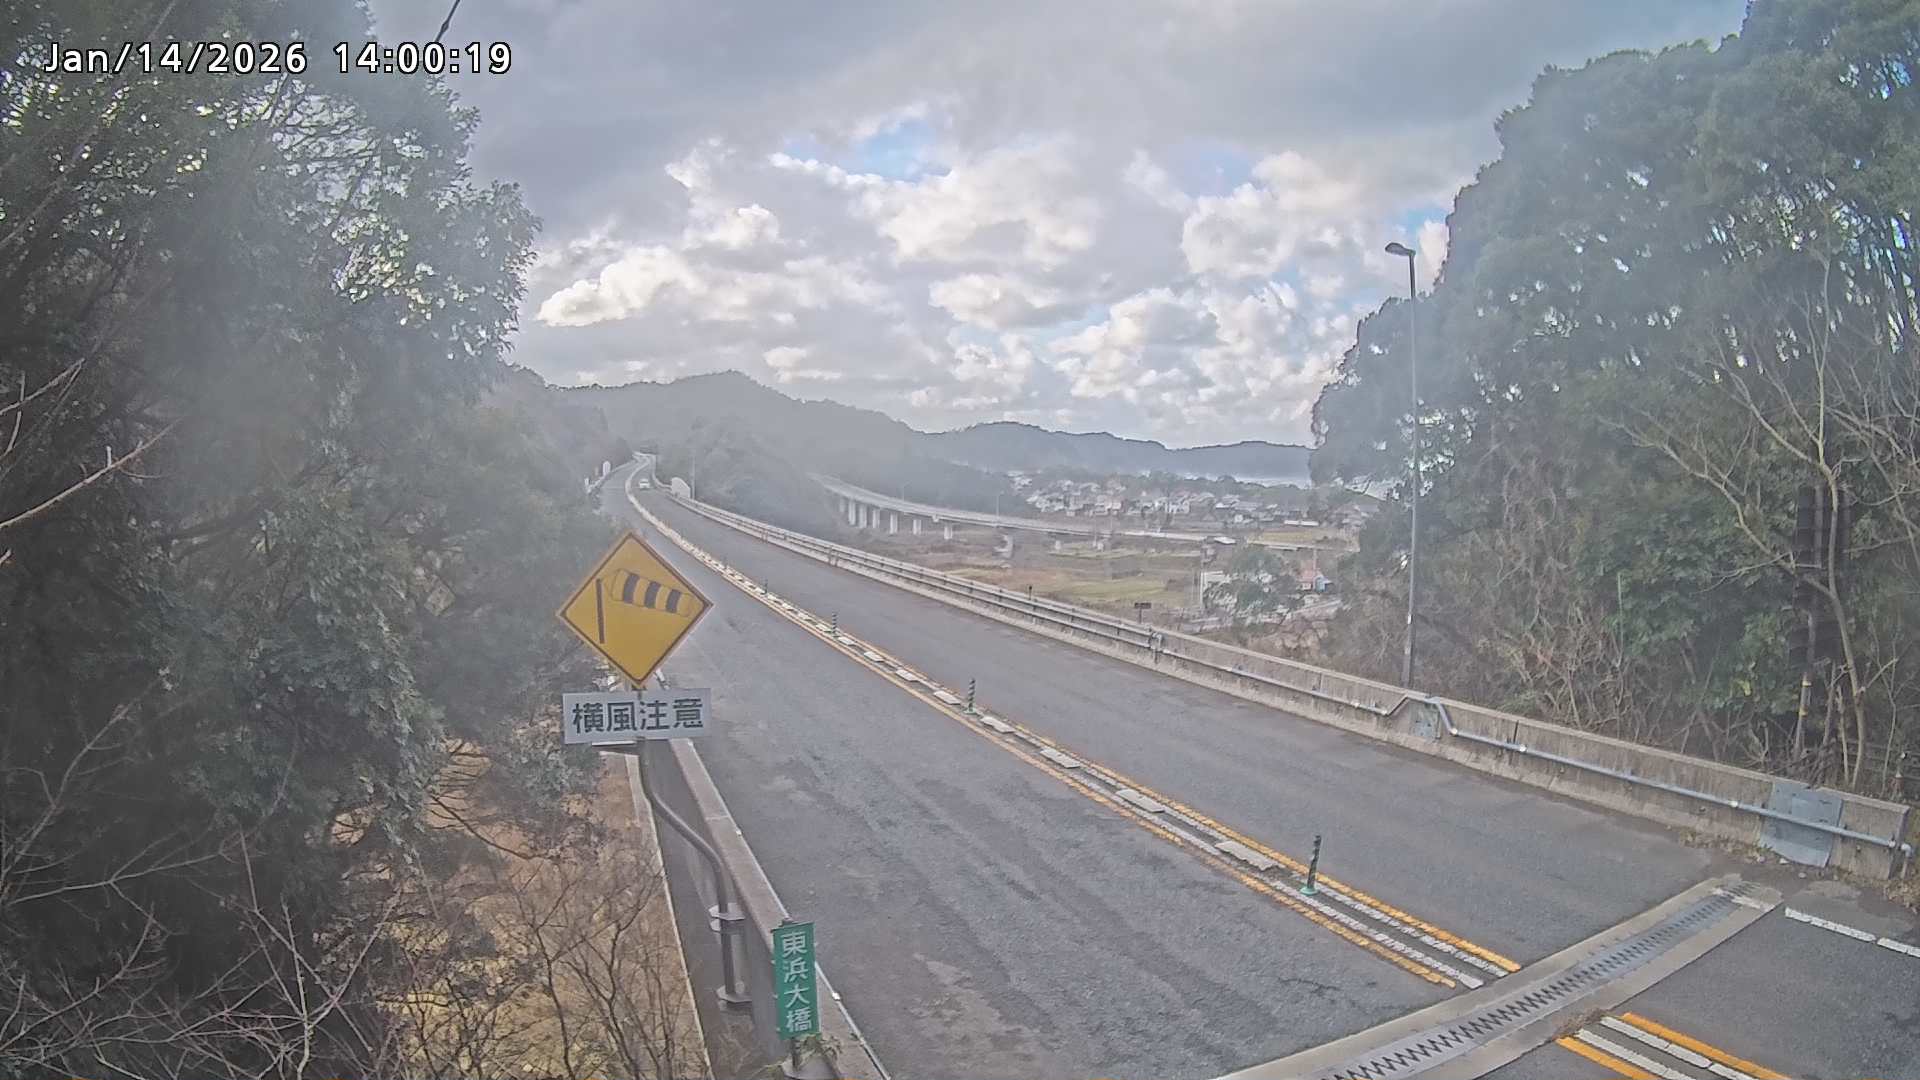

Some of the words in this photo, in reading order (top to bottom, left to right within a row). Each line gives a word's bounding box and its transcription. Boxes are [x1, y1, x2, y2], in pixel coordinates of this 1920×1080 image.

[572, 698, 703, 734] 横風注意
[780, 930, 812, 1033] 東浜大橋
